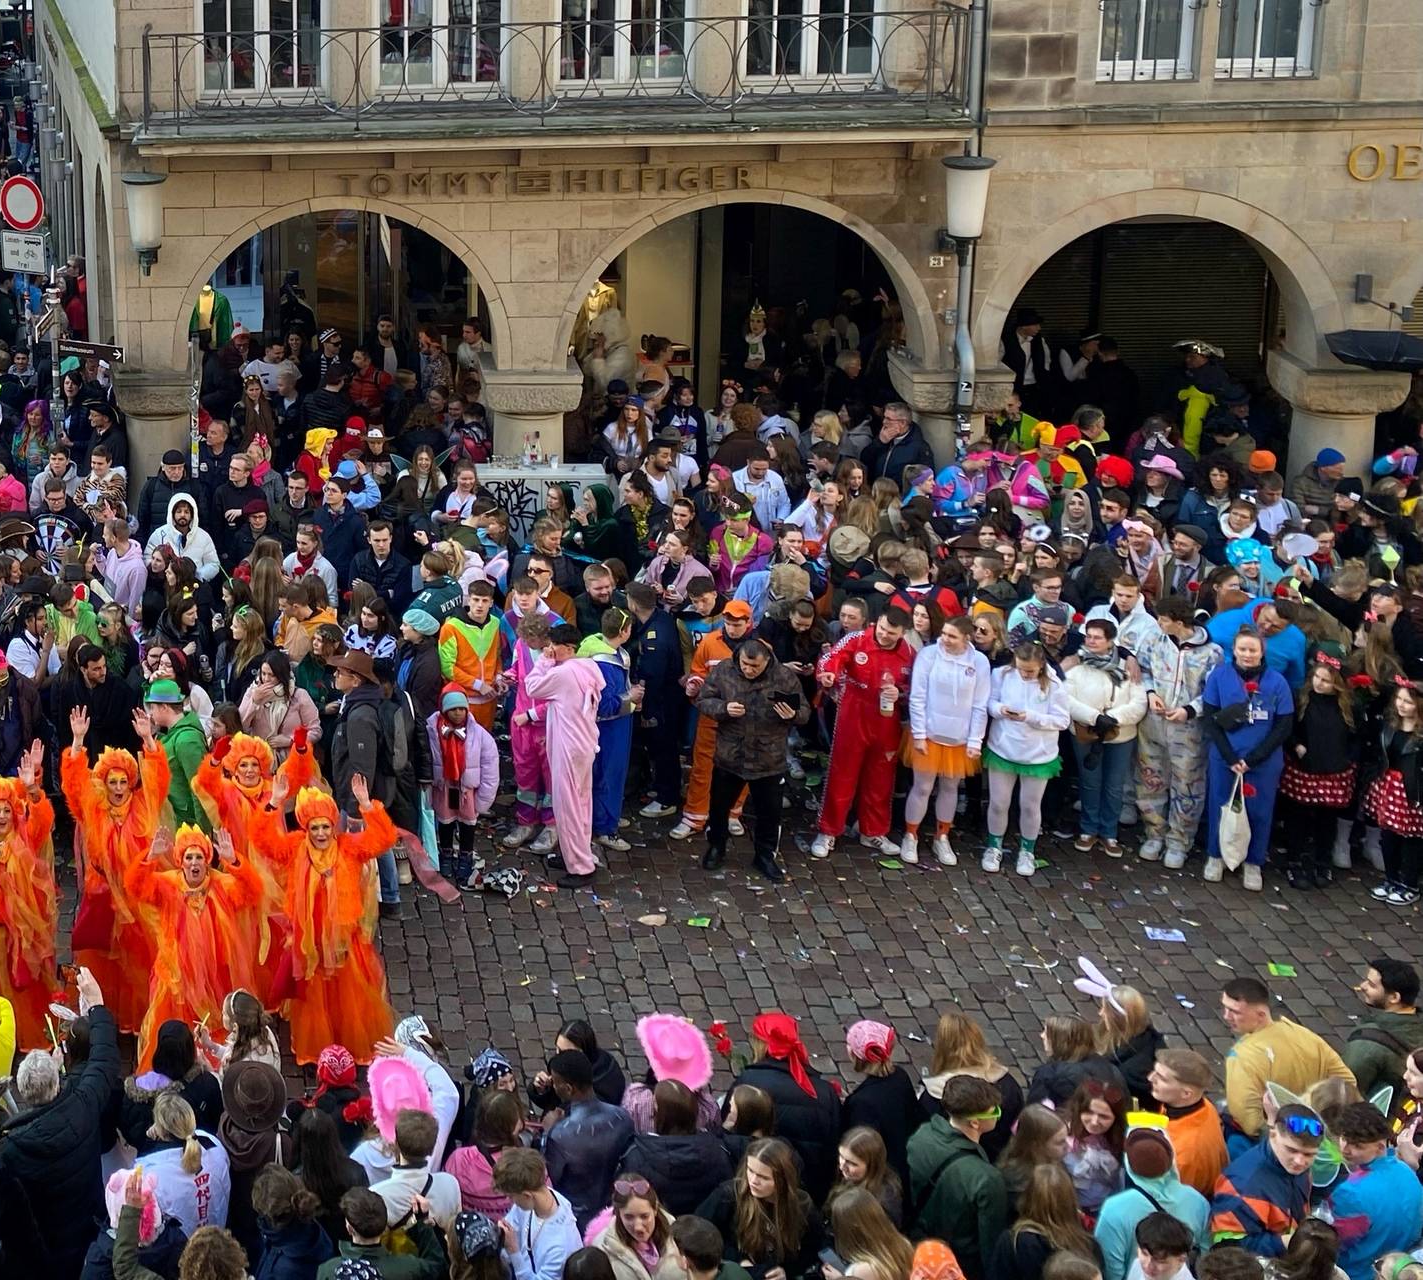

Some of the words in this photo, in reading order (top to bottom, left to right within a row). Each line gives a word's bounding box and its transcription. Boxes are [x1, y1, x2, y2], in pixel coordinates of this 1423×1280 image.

[1346, 143, 1423, 182] OE
[337, 171, 502, 198] TOMMY
[563, 165, 751, 194] HILFIGER
[17, 260, 30, 269] frei
[59, 344, 95, 355] Stadtmuseum
[194, 1173, 211, 1228] 四代目
